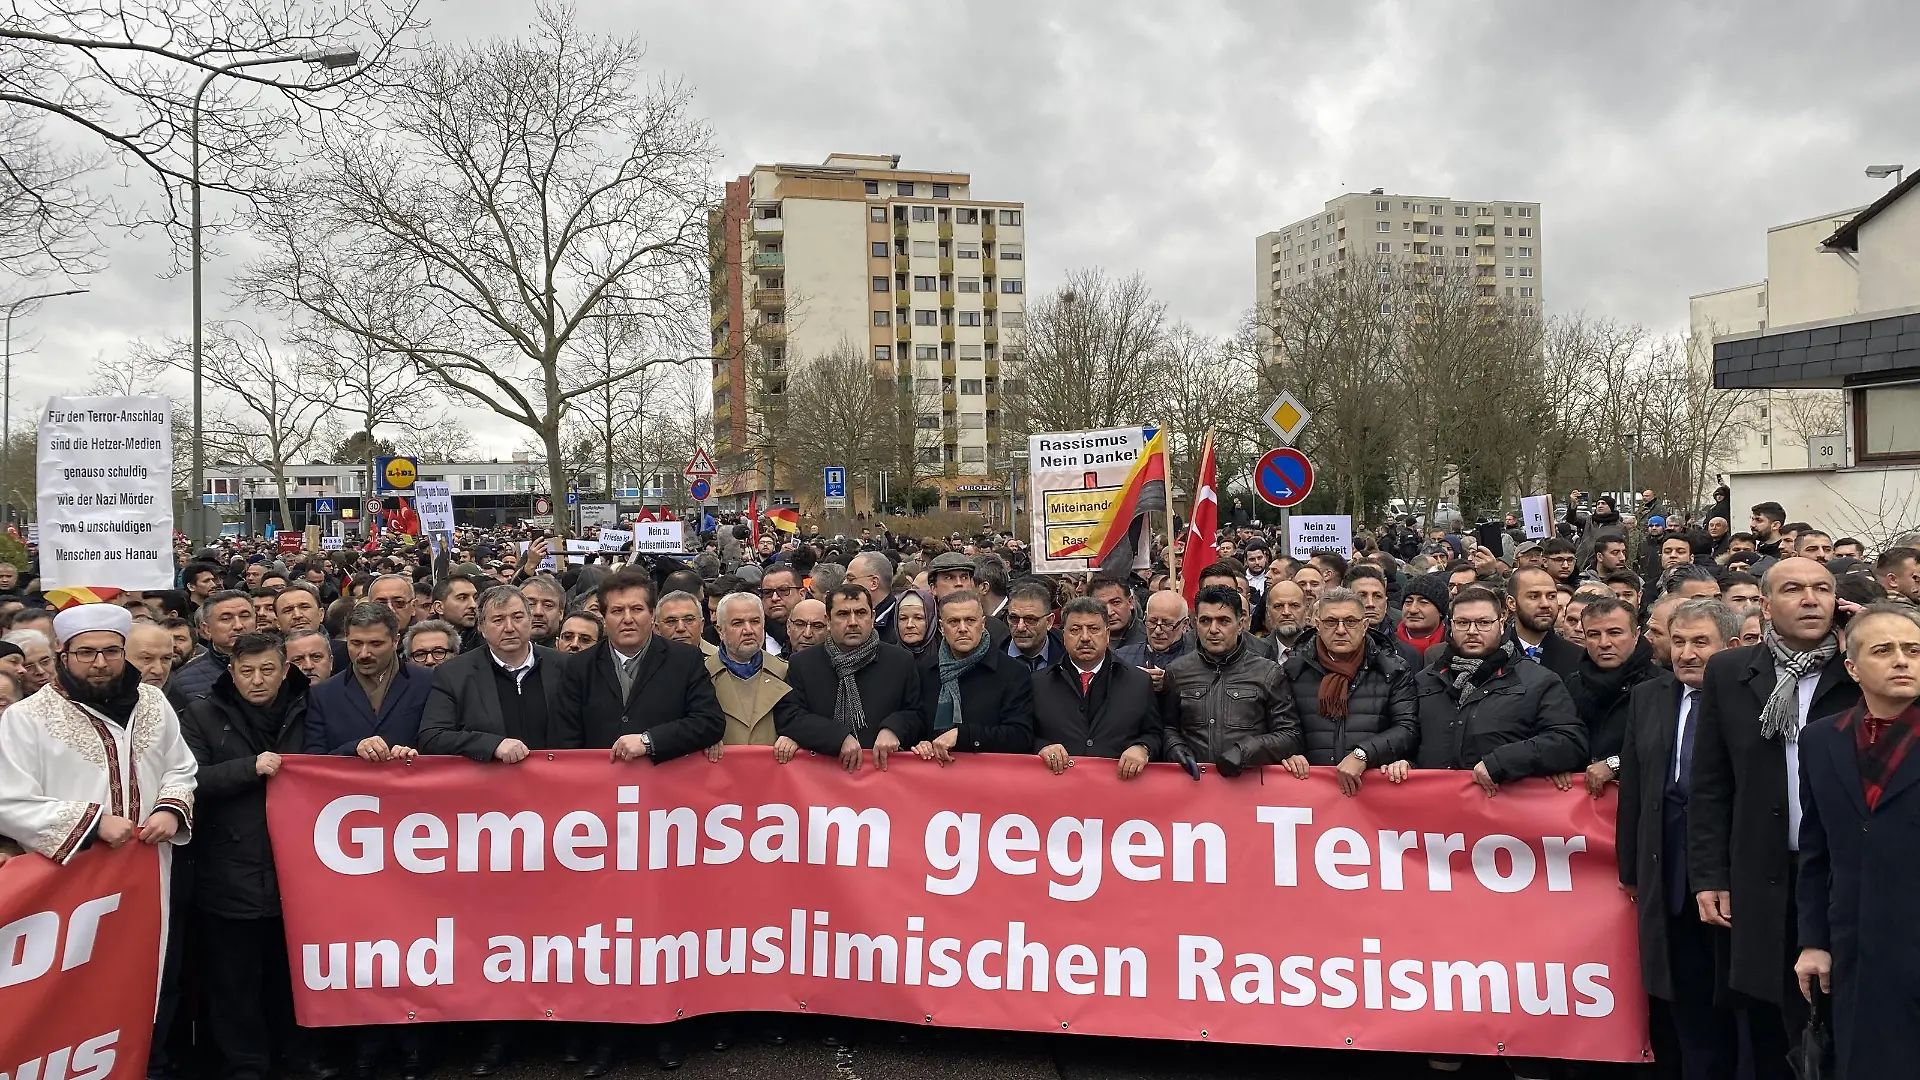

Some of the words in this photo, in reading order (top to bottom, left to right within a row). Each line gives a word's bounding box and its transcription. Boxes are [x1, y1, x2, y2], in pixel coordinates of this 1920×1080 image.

[48, 410, 65, 423] Für
[67, 410, 85, 423] den
[87, 410, 164, 424] Terror-Anschlag
[50, 438, 70, 450] sind
[73, 438, 88, 450] die
[91, 437, 161, 450] Hetzer-Medien
[1040, 435, 1128, 452] Rassismus
[1820, 445, 1834, 456] 30
[1040, 455, 1078, 468] Nein
[1083, 448, 1139, 465] Danke!
[64, 467, 105, 480] genauso
[108, 465, 147, 480] schuldig
[57, 493, 74, 506] wie
[77, 493, 93, 506] der
[96, 493, 117, 506] Nazi
[119, 492, 154, 505] Mörder
[568, 493, 576, 504] P
[369, 502, 379, 511] 30
[60, 523, 76, 533] von
[78, 521, 84, 533] 9
[87, 520, 152, 535] unschuldigen
[648, 526, 662, 536] Nein
[662, 528, 670, 536] zu
[1304, 522, 1324, 531] Nein
[1326, 523, 1336, 531] zu
[603, 532, 623, 542] Frieden
[1299, 534, 1340, 543] Fremden-
[638, 540, 681, 550] Antisemitismus
[55, 548, 101, 561] Menschen
[104, 550, 122, 560] aus
[125, 547, 158, 560] Hanau
[313, 786, 892, 876] Gemeinsam
[924, 809, 1227, 902] gegen
[1256, 806, 1586, 893] Terror
[303, 918, 454, 991] und
[483, 908, 1147, 998] antimuslimischen
[1178, 934, 1615, 1018] Rassismus
[0, 1029, 120, 1080] us
